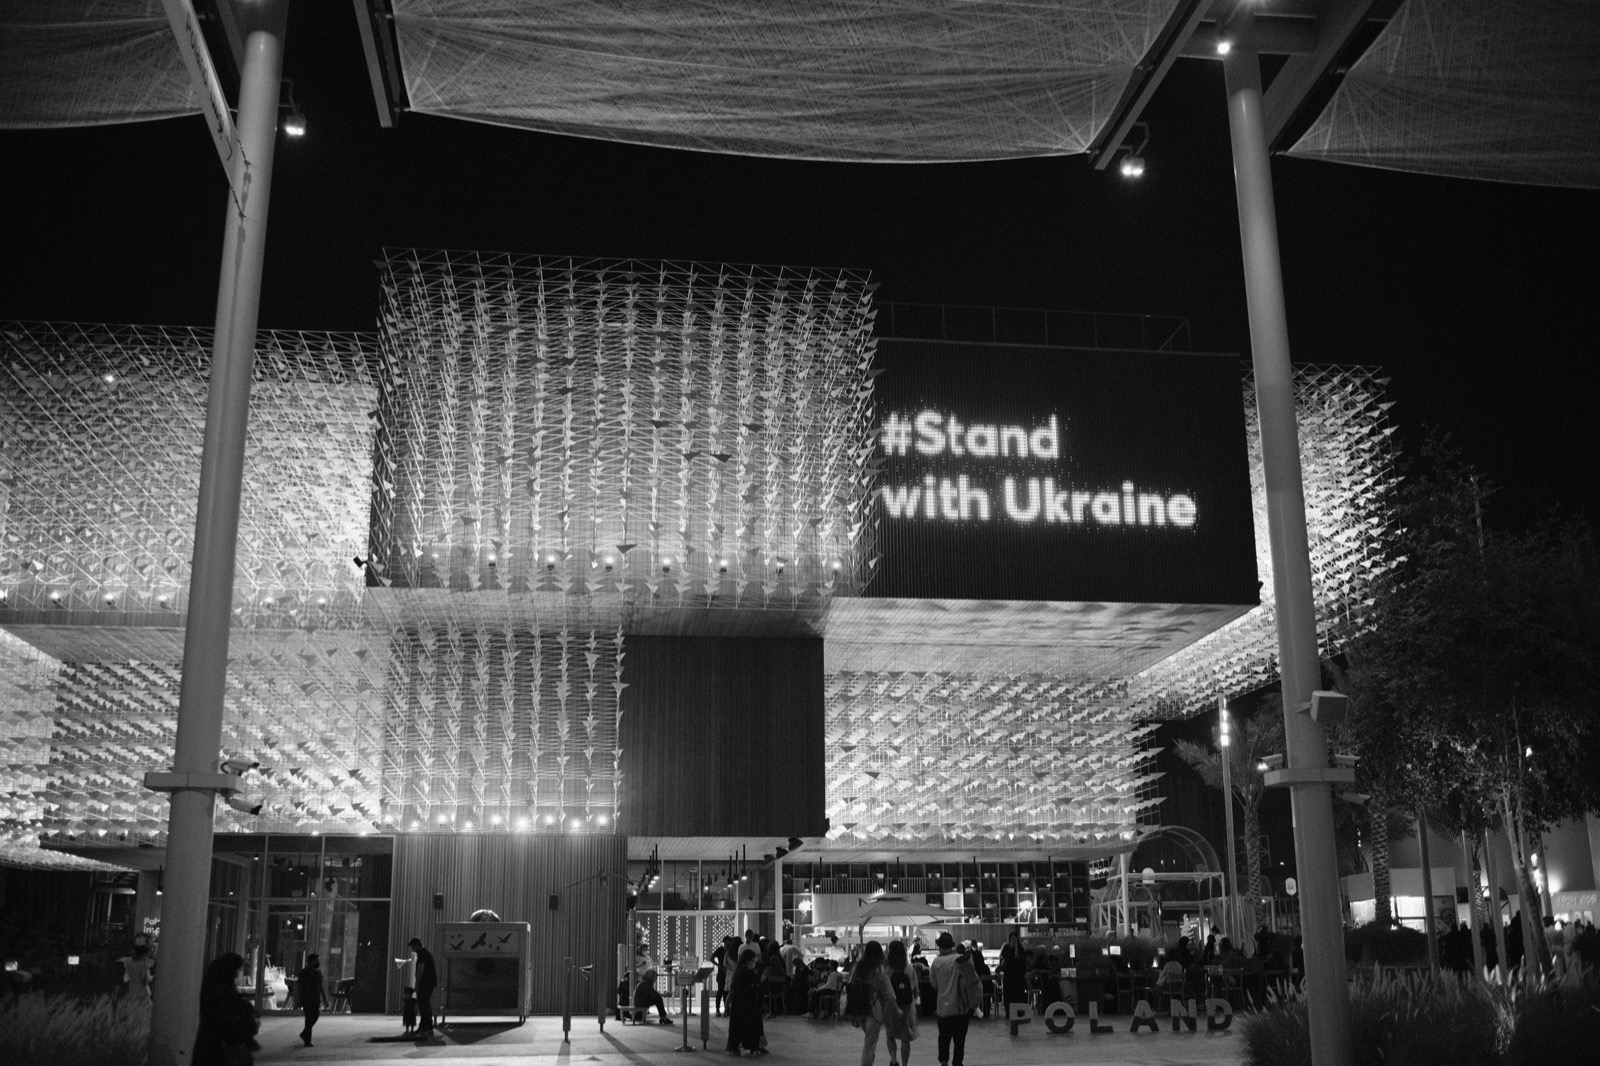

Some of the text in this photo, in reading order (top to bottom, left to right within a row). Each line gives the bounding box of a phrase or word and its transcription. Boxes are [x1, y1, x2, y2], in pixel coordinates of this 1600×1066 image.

[881, 409, 1060, 459] #Stand
[881, 473, 1197, 527] with Ukraine
[1009, 998, 1233, 1035] POLAND
